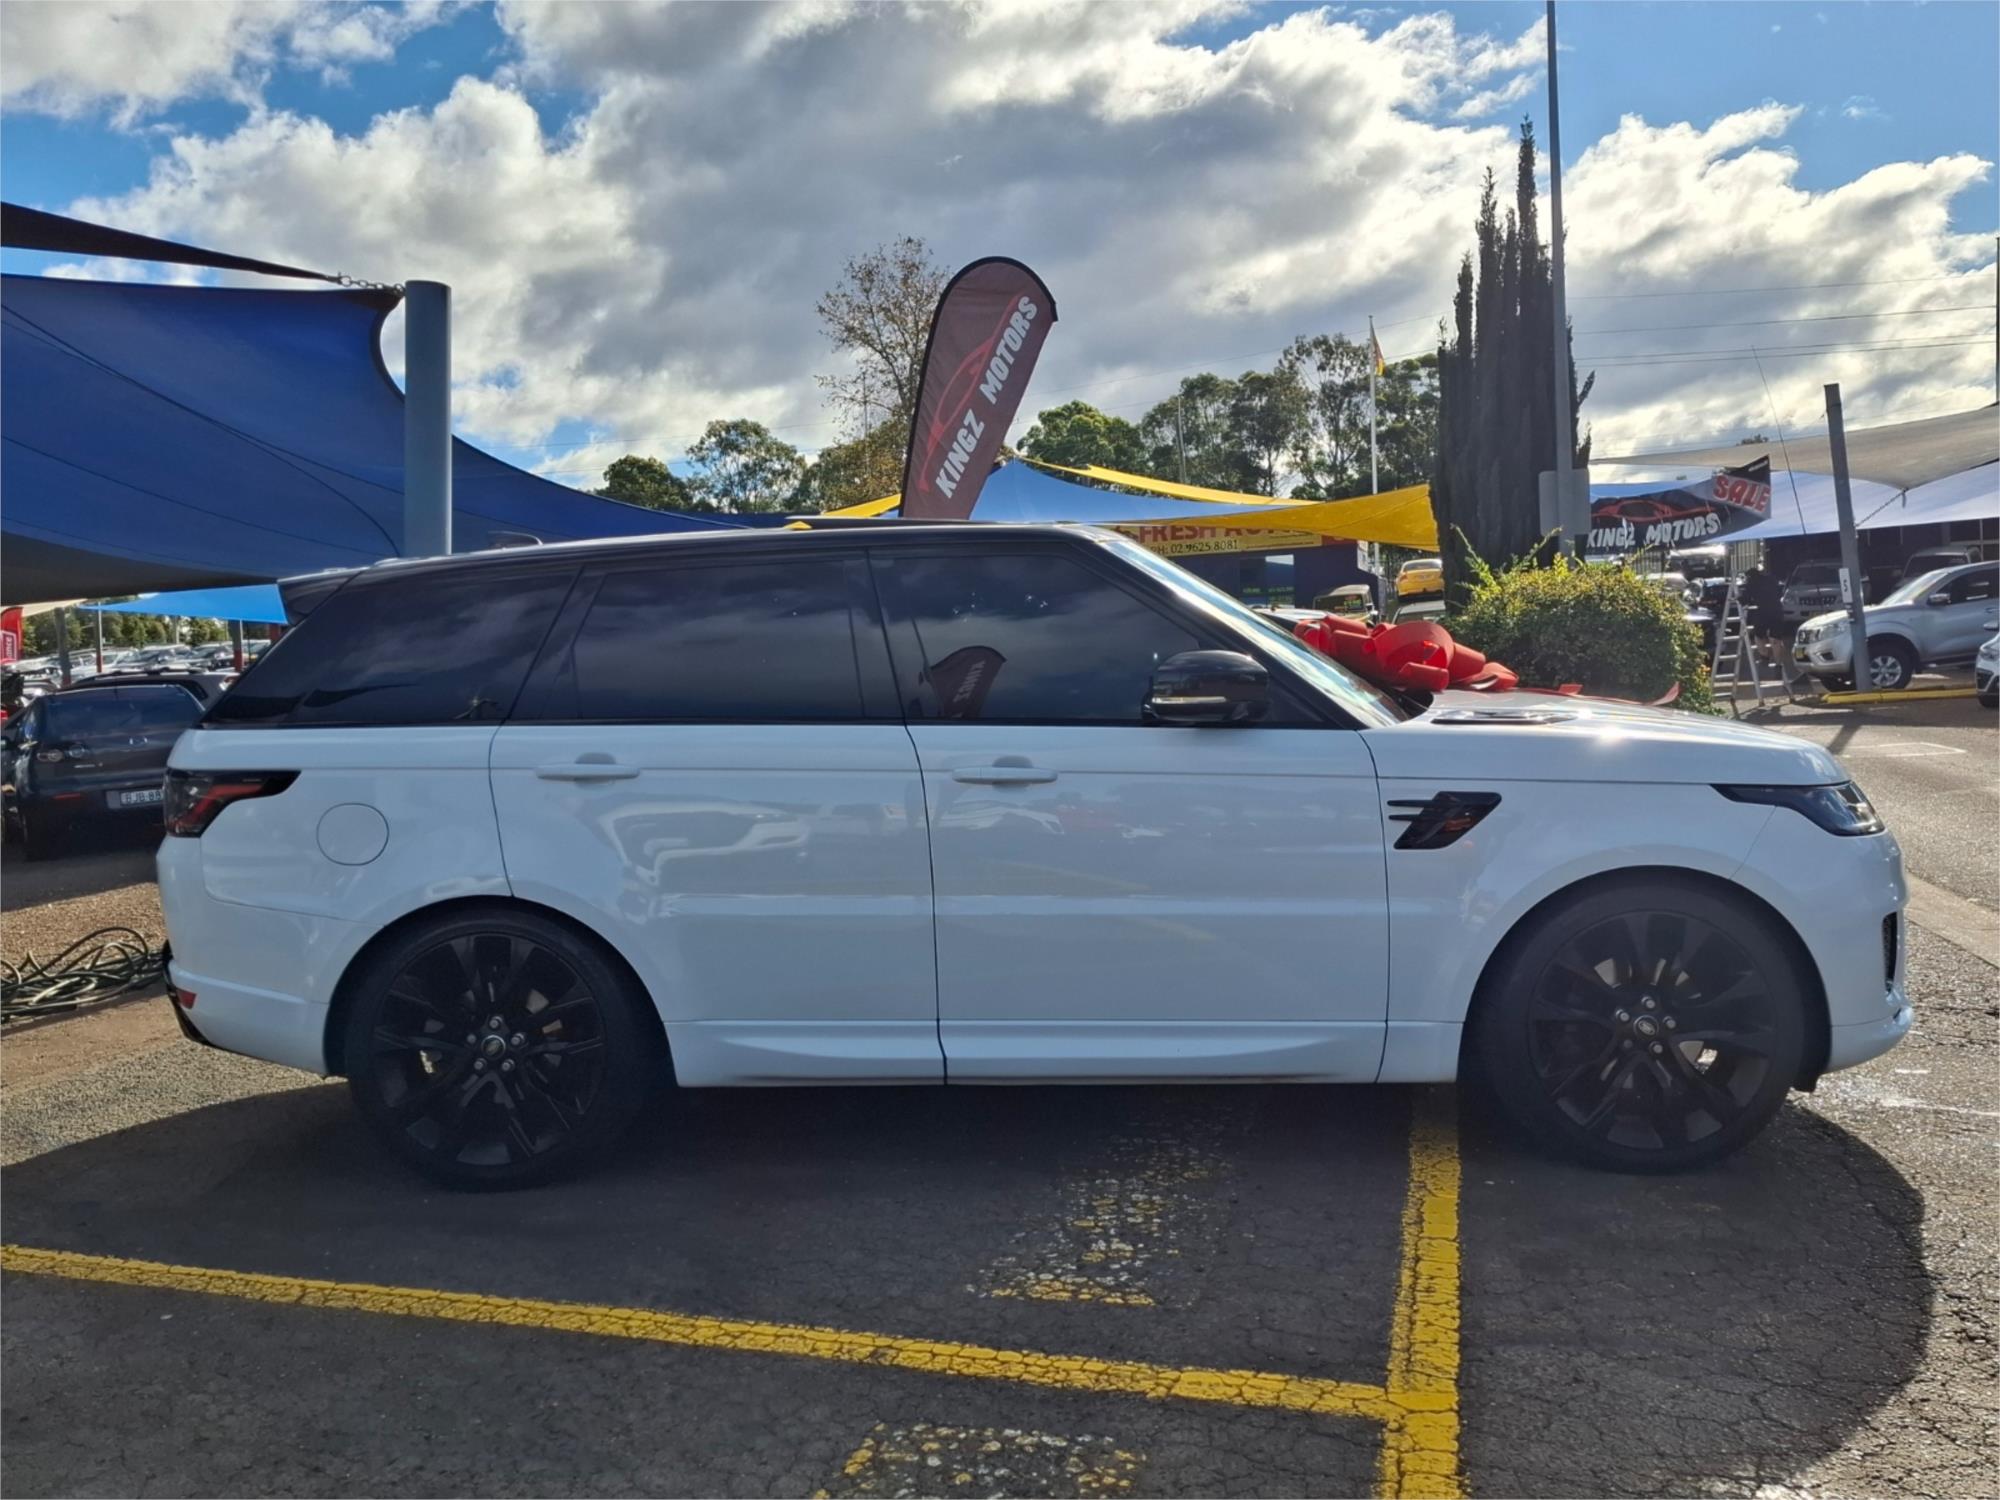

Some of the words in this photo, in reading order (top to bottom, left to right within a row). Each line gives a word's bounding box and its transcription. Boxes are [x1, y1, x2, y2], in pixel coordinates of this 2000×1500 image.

[935, 409, 985, 498] KINGZ
[979, 296, 1038, 404] MOTORS
[1713, 475, 1770, 513] SALE
[1139, 525, 1216, 543] FRESH
[1171, 543, 1183, 553] 02
[1186, 542, 1211, 552] 9625
[1214, 539, 1237, 550] 8081
[1646, 513, 1720, 546] MOTORS
